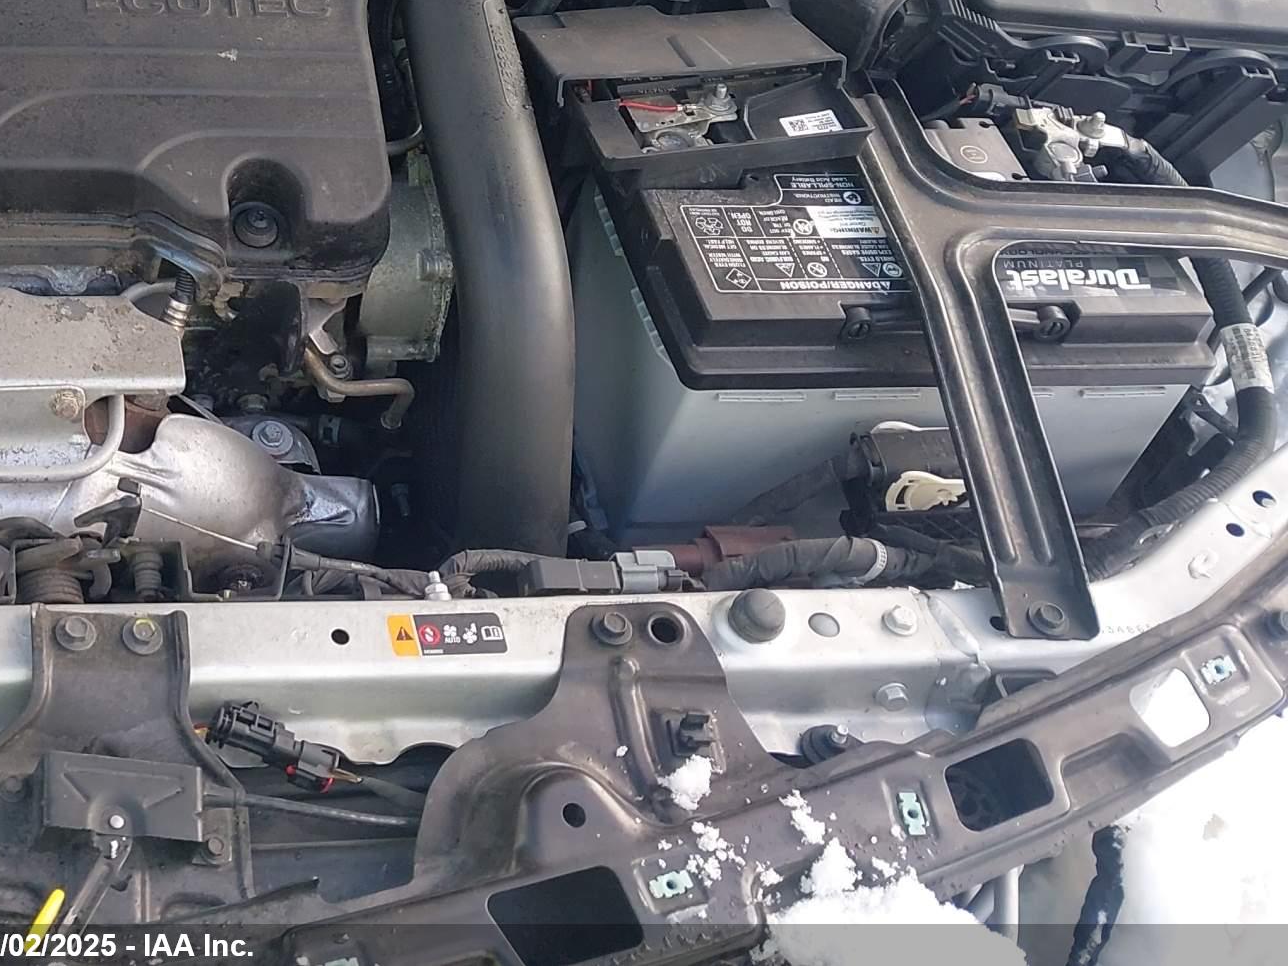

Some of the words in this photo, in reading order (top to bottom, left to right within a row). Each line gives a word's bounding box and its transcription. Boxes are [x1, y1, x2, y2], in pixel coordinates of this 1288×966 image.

[1003, 259, 1084, 269] PLATINUM
[1006, 268, 1152, 291] Duralast
[779, 281, 881, 290] DANGER/POISON
[444, 636, 461, 644] AUTO
